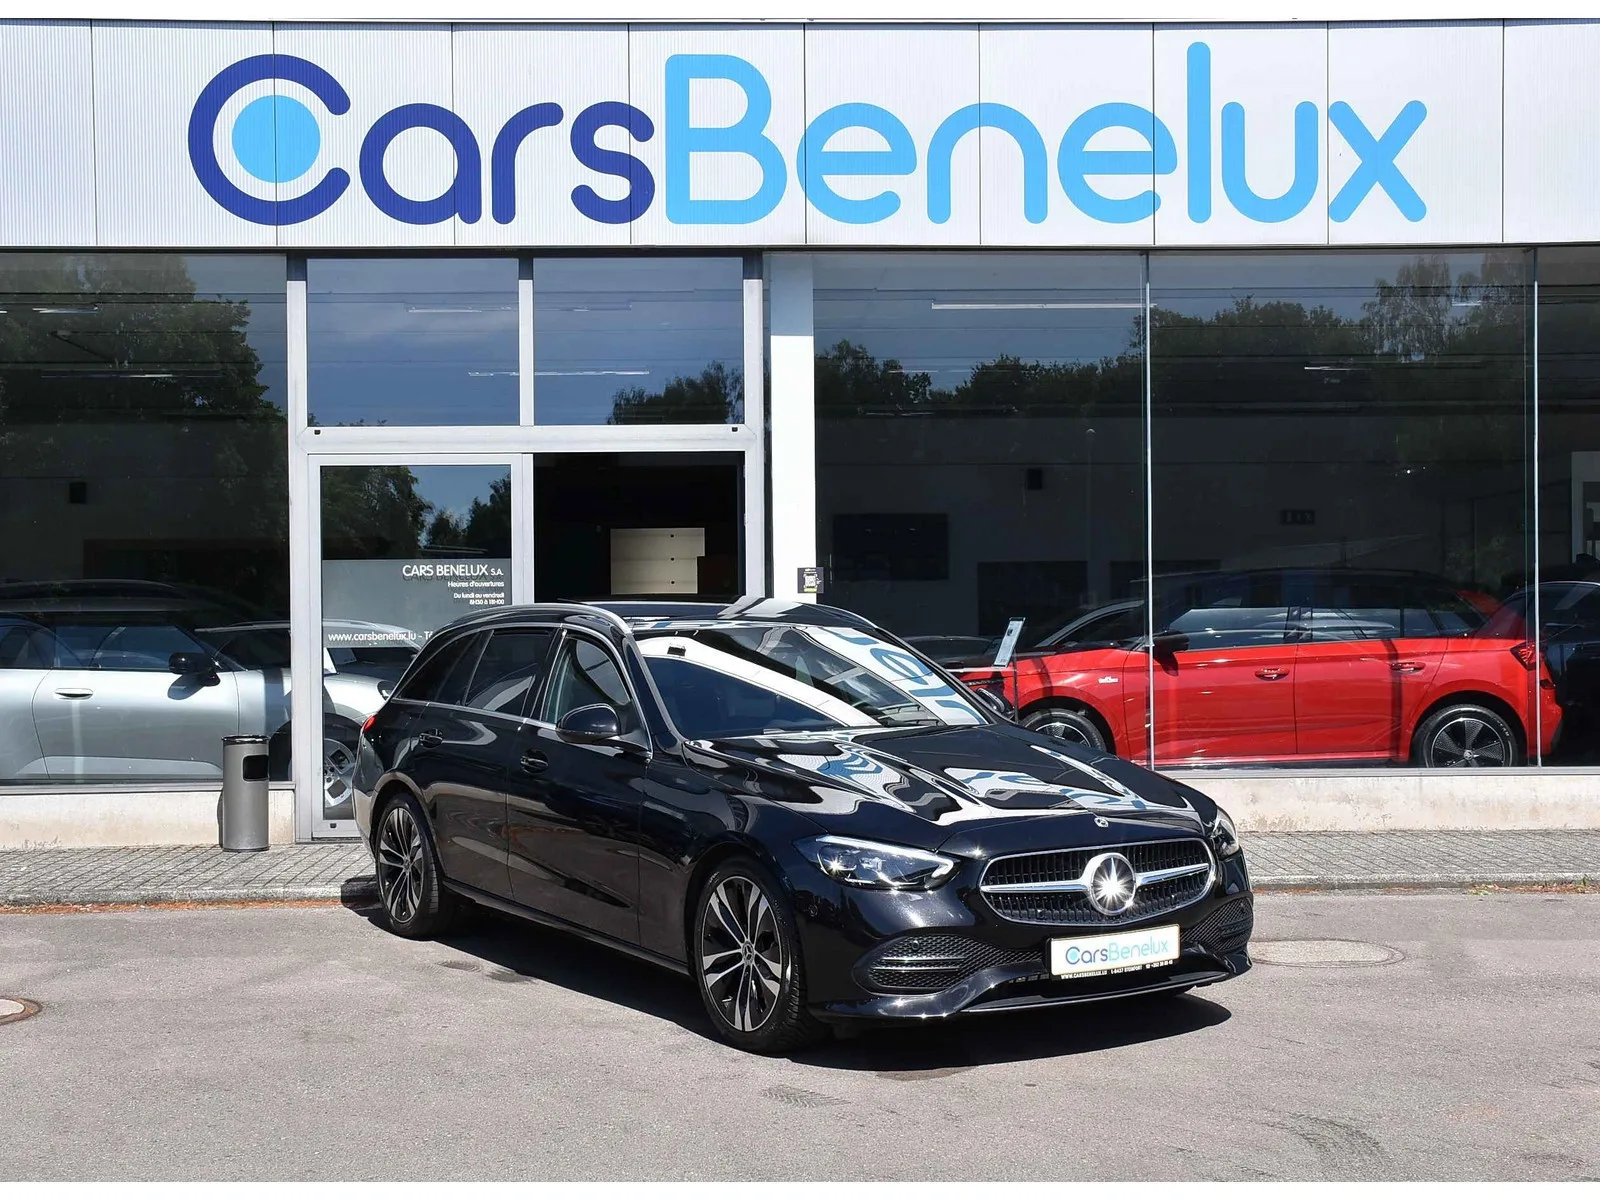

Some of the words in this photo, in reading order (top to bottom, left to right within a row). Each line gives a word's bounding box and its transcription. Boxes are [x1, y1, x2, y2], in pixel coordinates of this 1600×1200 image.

[188, 42, 1427, 225] CarsBenelux
[402, 564, 434, 576] CARS
[436, 564, 488, 576] BENELUX
[328, 631, 416, 641] www.carsbenelux.lu
[1065, 936, 1169, 966] CarsBenelux
